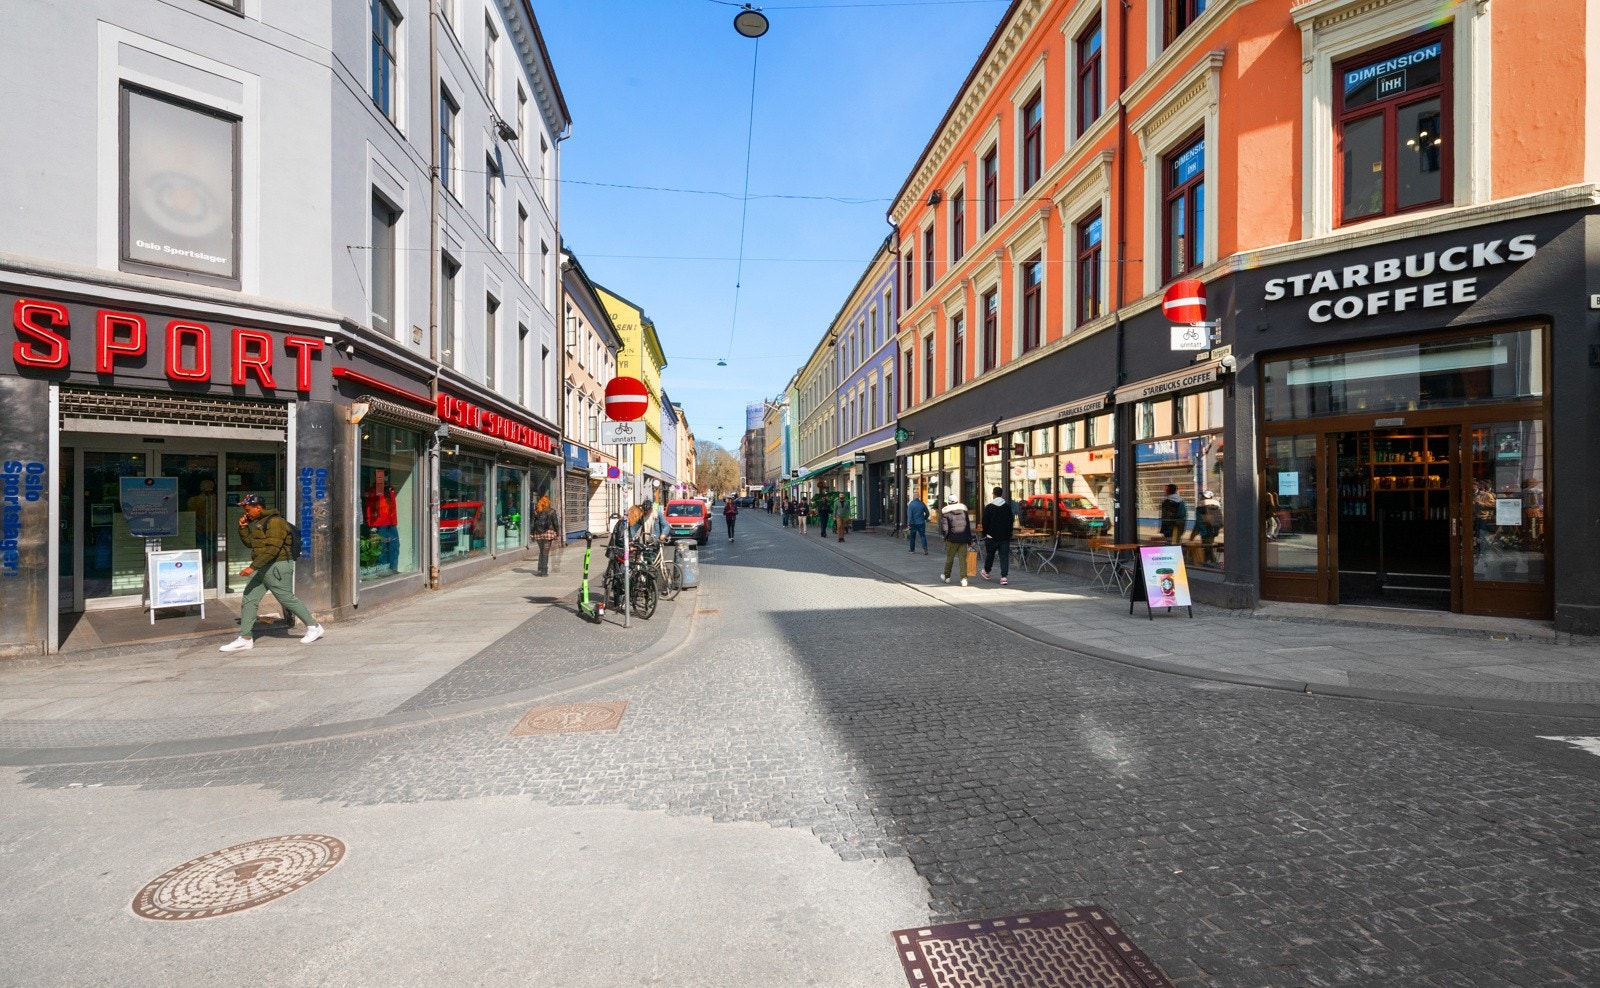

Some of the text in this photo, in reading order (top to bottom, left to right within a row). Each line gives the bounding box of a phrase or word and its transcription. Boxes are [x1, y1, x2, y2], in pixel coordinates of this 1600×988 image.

[1348, 46, 1437, 84] DIMENSION
[135, 240, 228, 263] Oslo Sportslager
[1264, 234, 1537, 301] STARBUCKS
[1308, 277, 1478, 323] COFFEE
[13, 299, 323, 392] SPORT
[1143, 371, 1211, 396] STARBUCKS COFFEE
[438, 392, 479, 429] OSLO
[1058, 401, 1102, 418] STARBUCKS COFFEE
[612, 435, 637, 443] unntatt
[25, 462, 45, 502] Oslo
[315, 467, 329, 499] Oslo
